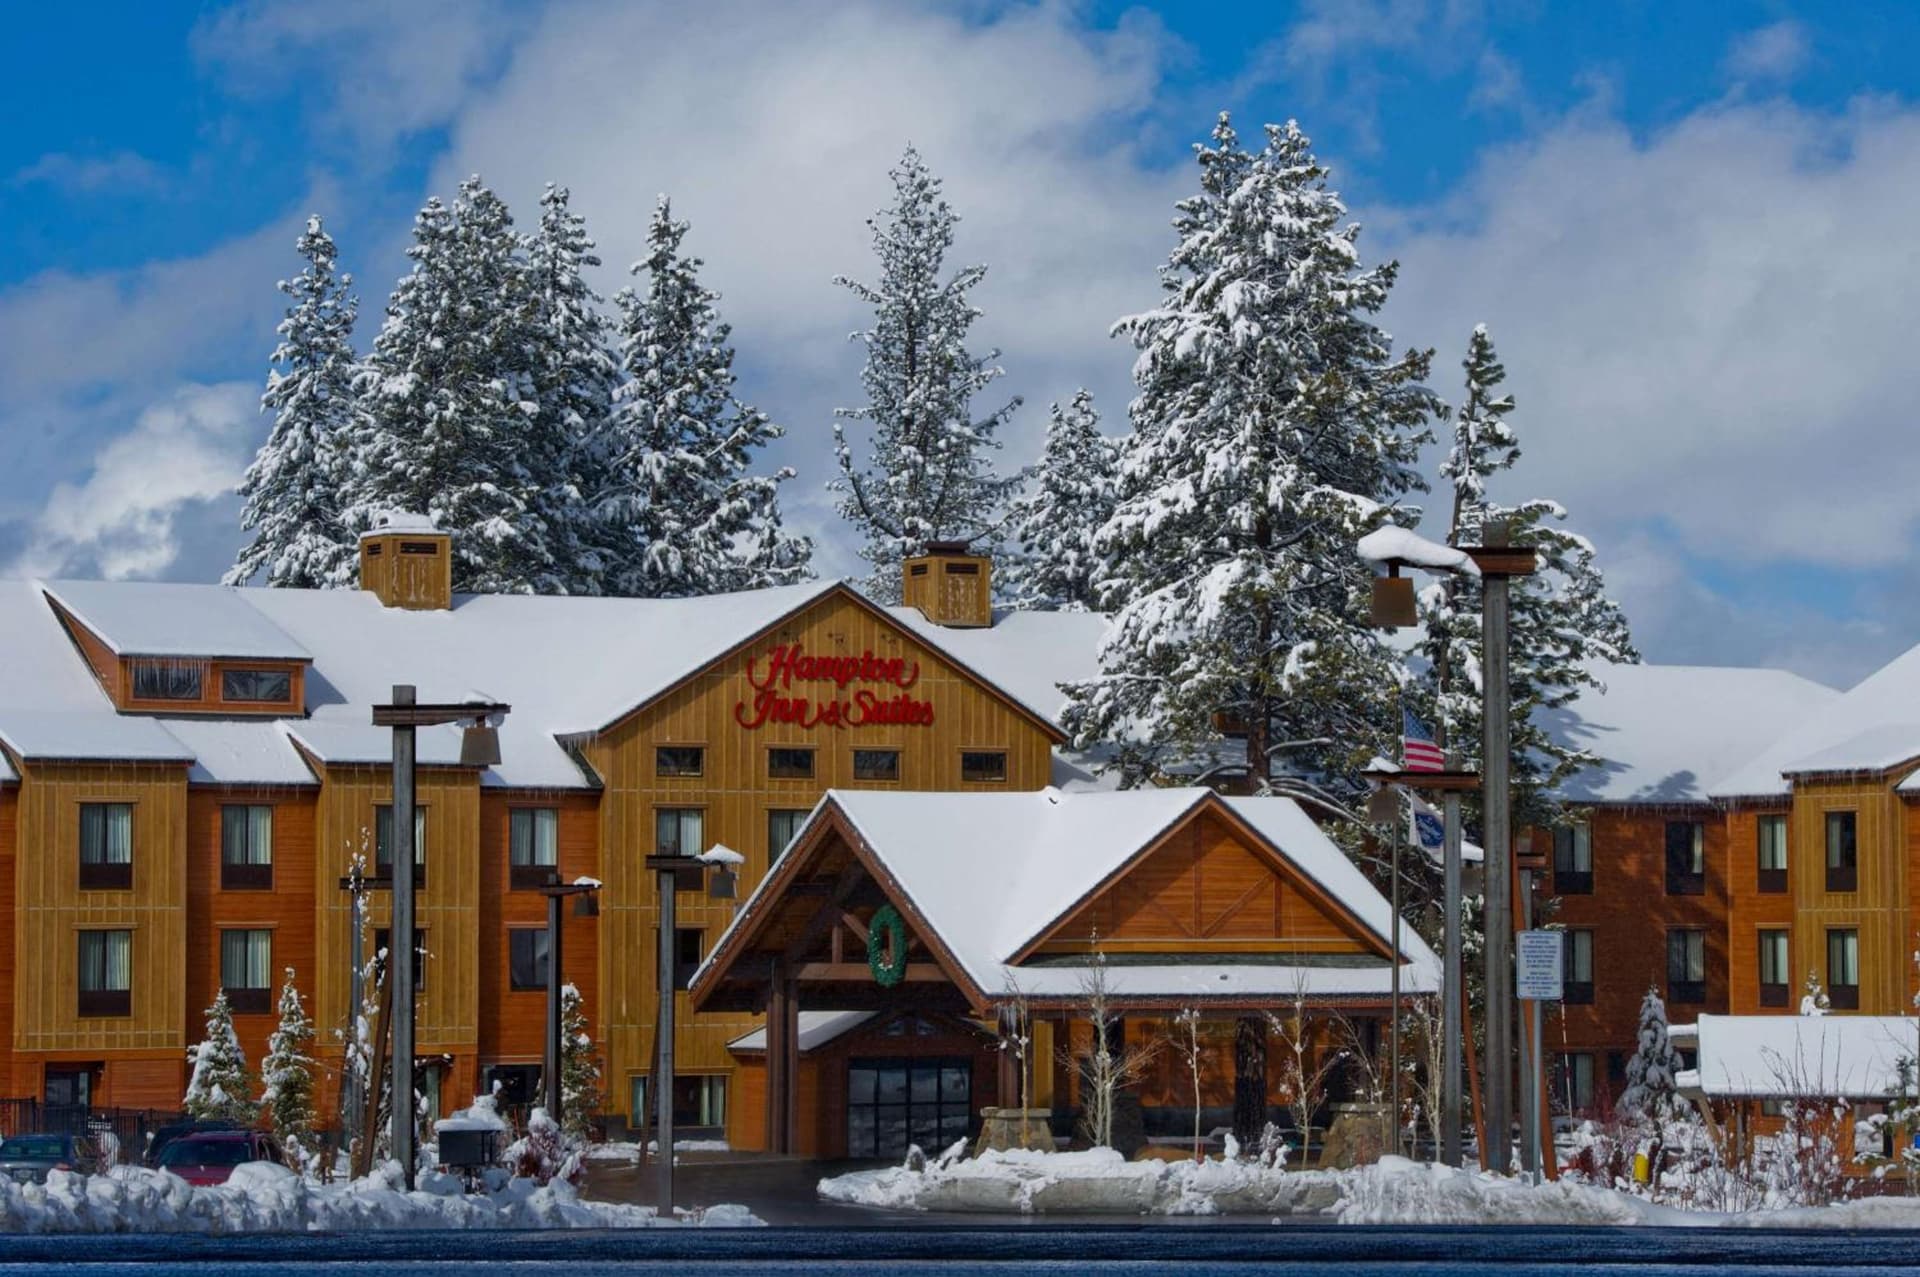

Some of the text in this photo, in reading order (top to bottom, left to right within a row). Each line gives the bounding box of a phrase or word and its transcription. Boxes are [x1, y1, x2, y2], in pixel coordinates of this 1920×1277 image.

[747, 644, 919, 689] Hampton
[735, 689, 825, 729] Inn
[842, 689, 934, 727] Suites
